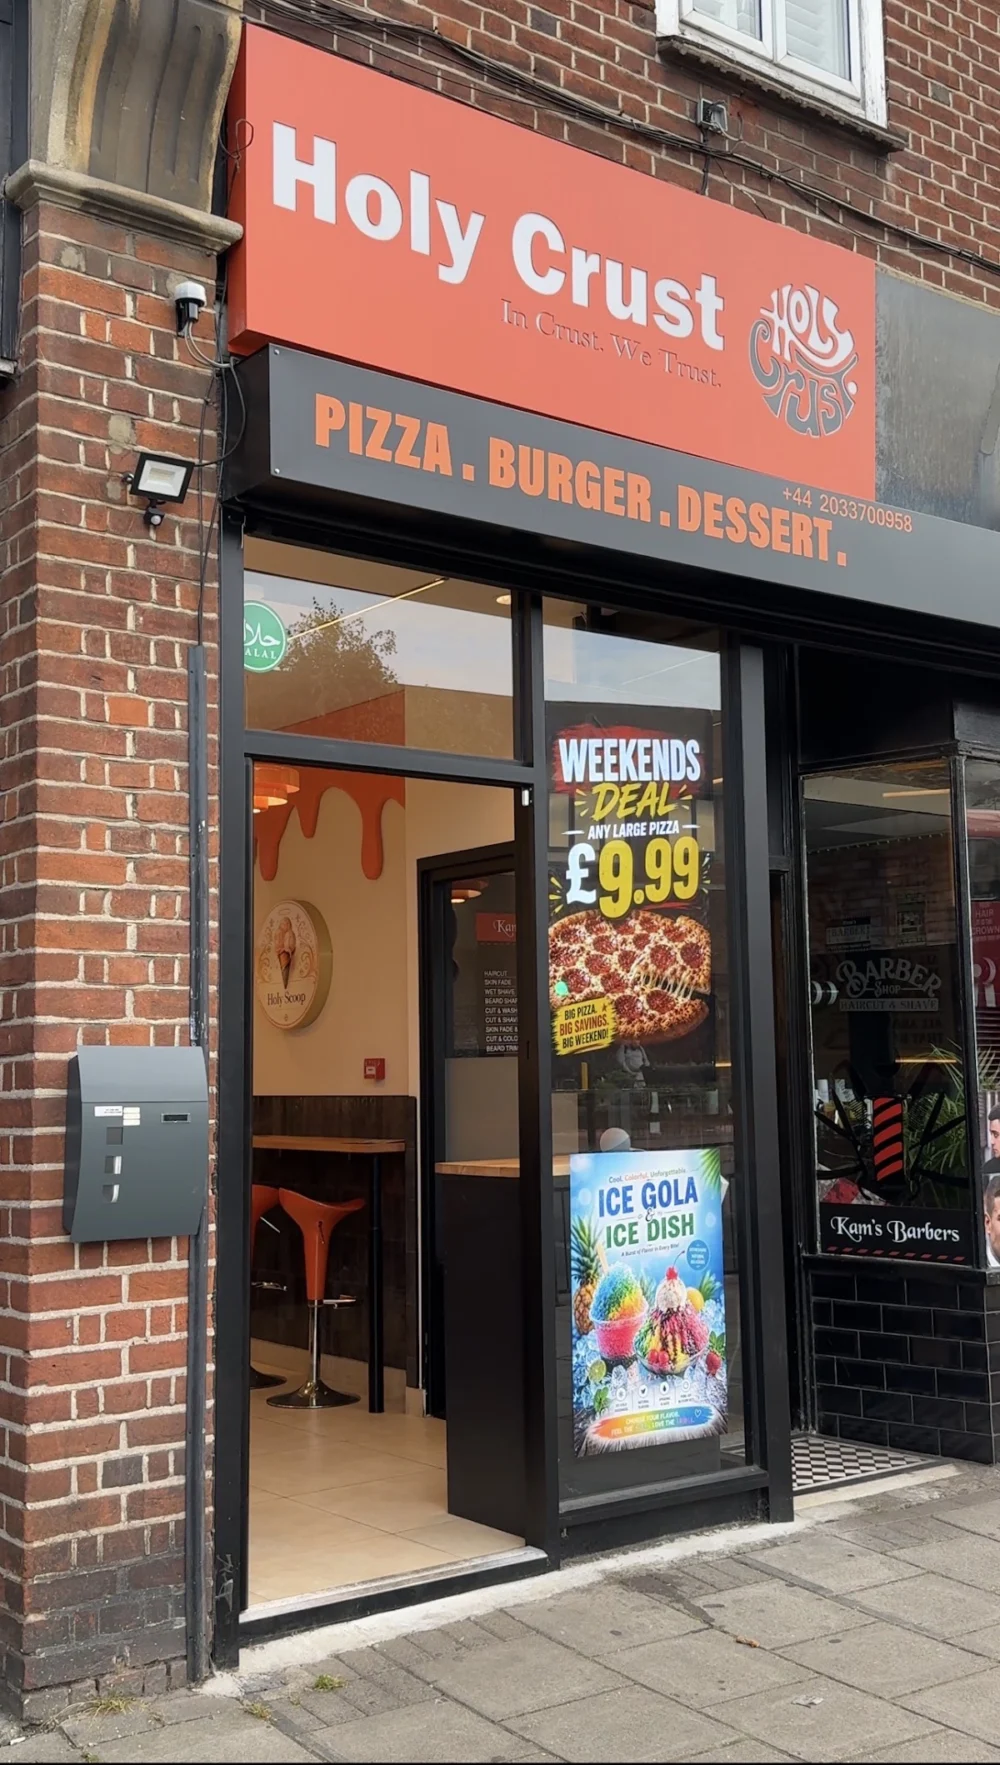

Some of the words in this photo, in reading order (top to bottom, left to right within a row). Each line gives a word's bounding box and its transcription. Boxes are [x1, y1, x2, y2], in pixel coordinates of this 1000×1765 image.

[272, 121, 487, 285] Holy
[511, 211, 726, 352] Crust
[501, 298, 529, 331] In
[535, 311, 605, 353] Crust.
[610, 332, 653, 367] We
[658, 347, 723, 389] Trust.
[782, 487, 813, 509] +44
[818, 493, 914, 534] 2033700958
[244, 647, 277, 660] ALAL
[558, 738, 701, 783] WEEKENDS
[590, 781, 679, 822] DEAL
[587, 824, 612, 840] ANY
[612, 821, 648, 838] LARGE
[649, 820, 680, 835] PIZZA
[566, 836, 700, 919] £9.99
[975, 908, 994, 919] HAIR
[267, 991, 283, 1008] Holy
[284, 990, 306, 1006] Scoop
[841, 1000, 886, 1011] HAIRCUT
[900, 1000, 937, 1011] SHAVE
[564, 1008, 576, 1021] BIG
[559, 1021, 573, 1036] BIG
[562, 1036, 574, 1049] BIG
[575, 1028, 609, 1046] WEEKEND!
[598, 1184, 634, 1218] ICE
[641, 1176, 699, 1211] GOLA
[606, 1221, 639, 1249] ICE
[646, 1212, 694, 1242] DISH
[830, 1216, 883, 1242] Kam's
[886, 1220, 960, 1243] Barbers
